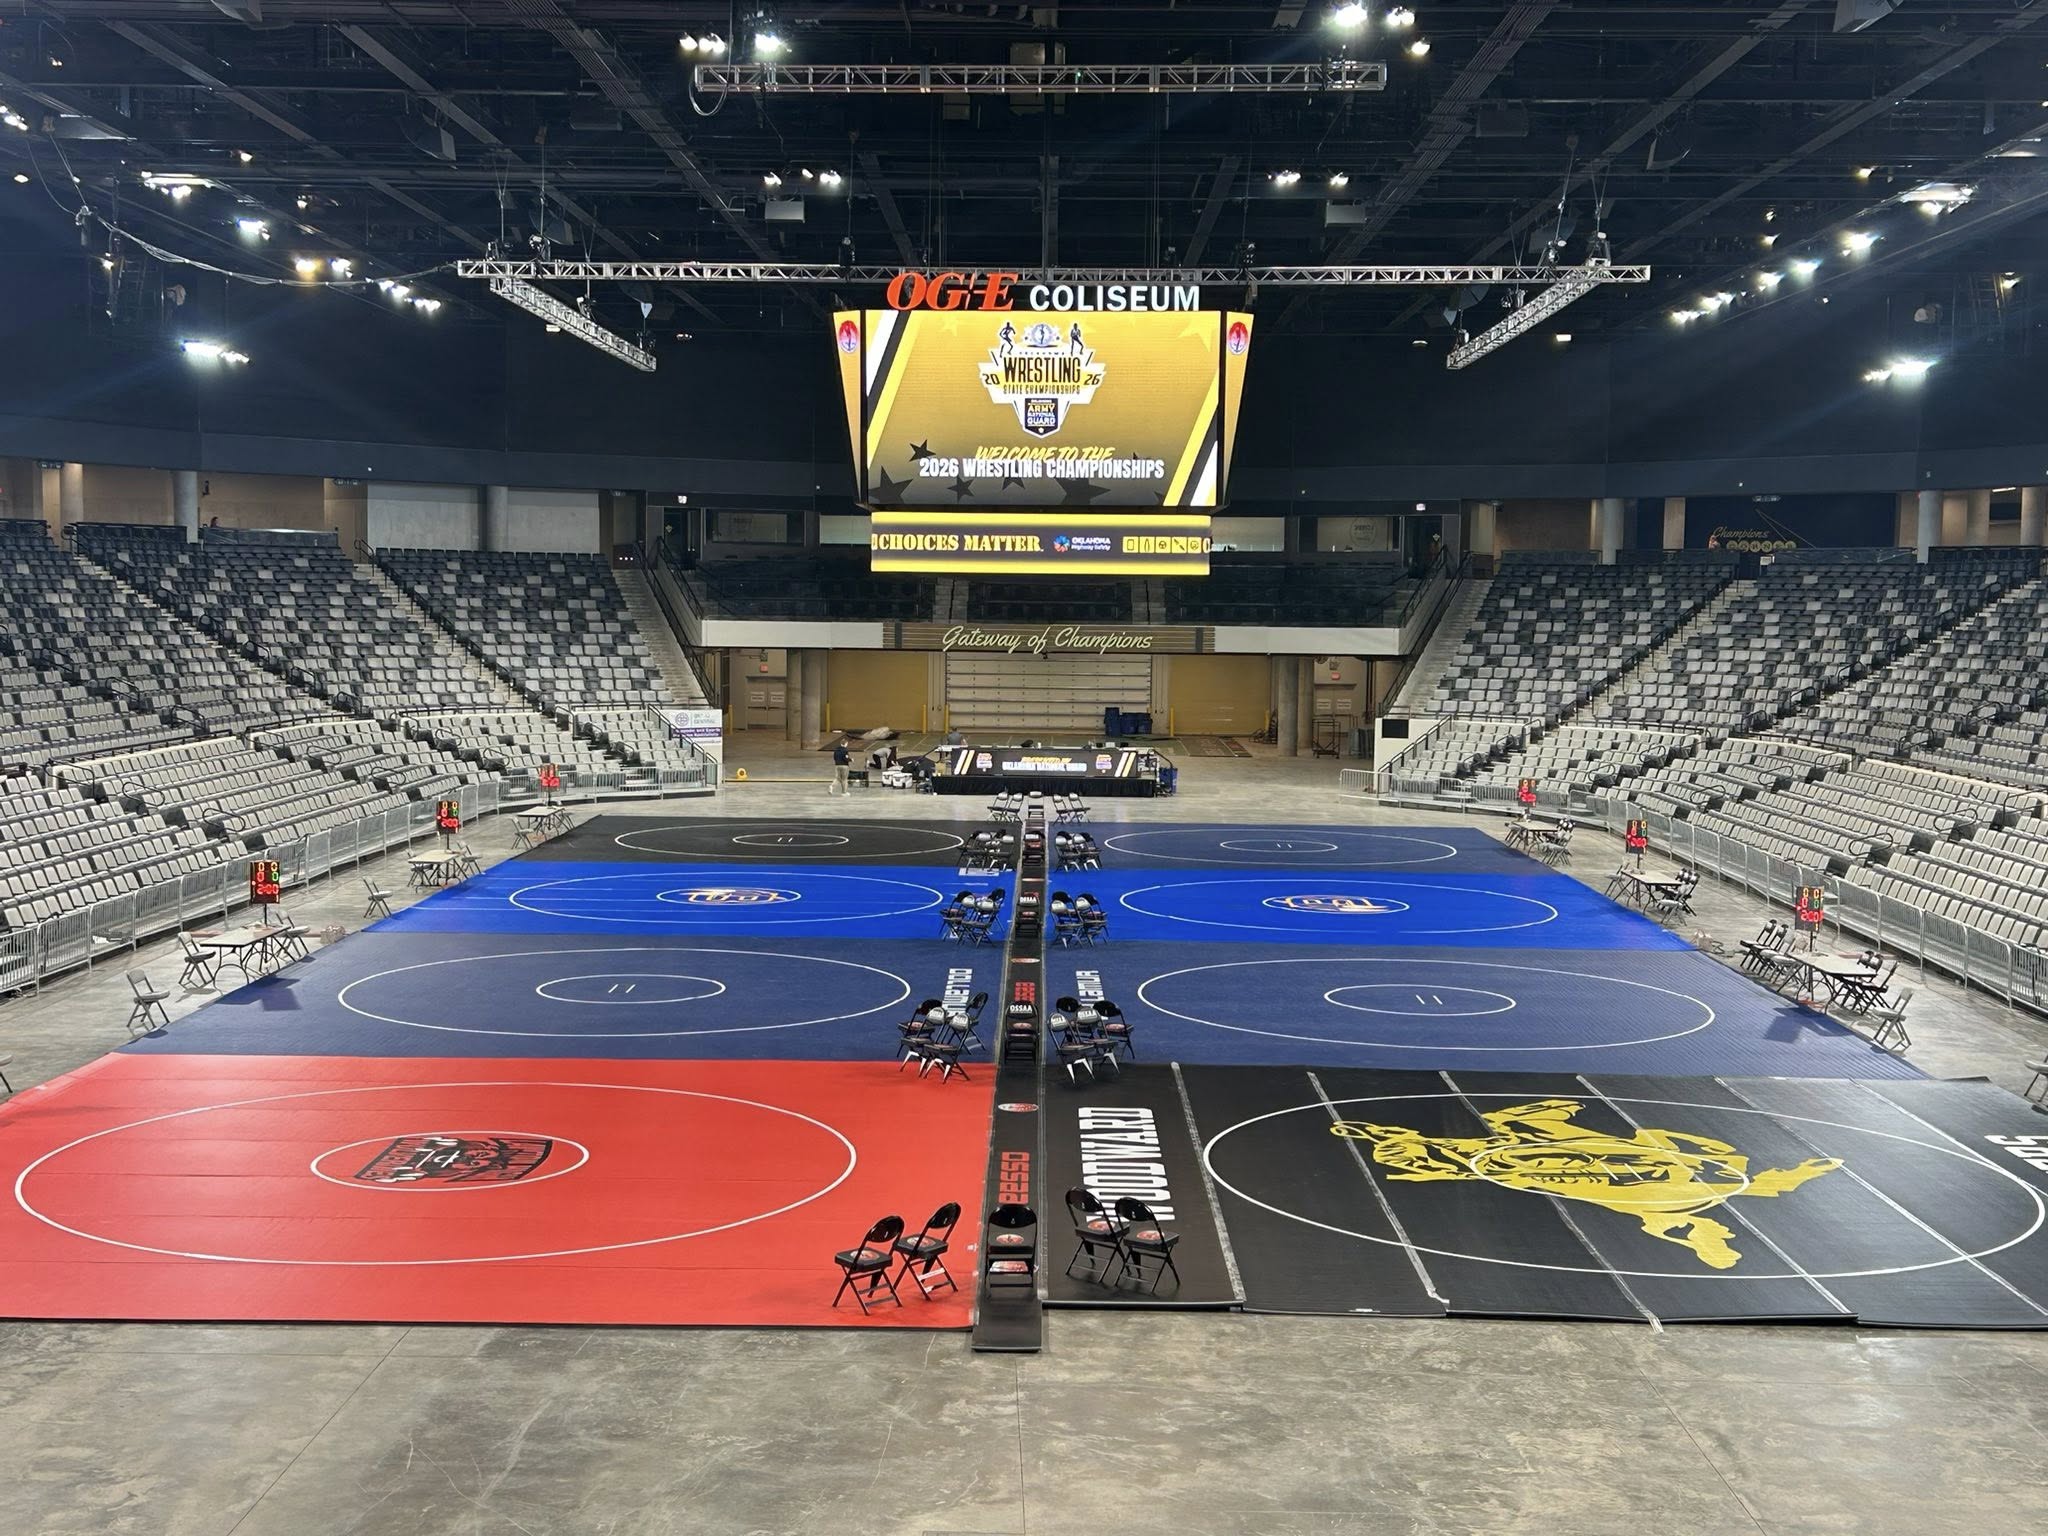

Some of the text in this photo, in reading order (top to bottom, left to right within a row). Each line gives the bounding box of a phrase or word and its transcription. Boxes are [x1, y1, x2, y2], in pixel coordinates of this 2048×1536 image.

[1029, 284, 1200, 311] COLISEUM
[1003, 357, 1081, 383] WRESTLING
[1028, 404, 1055, 412] ARMY
[974, 446, 1115, 461] WELCOME TO THE
[919, 458, 1165, 479] 2026 WRESTLING CHAMPIONSHIPS
[879, 533, 959, 551] CHOICES
[942, 625, 1153, 655] Gateway of Champions
[1010, 1004, 1033, 1012] OSSAA
[998, 1152, 1030, 1204] OSSAA
